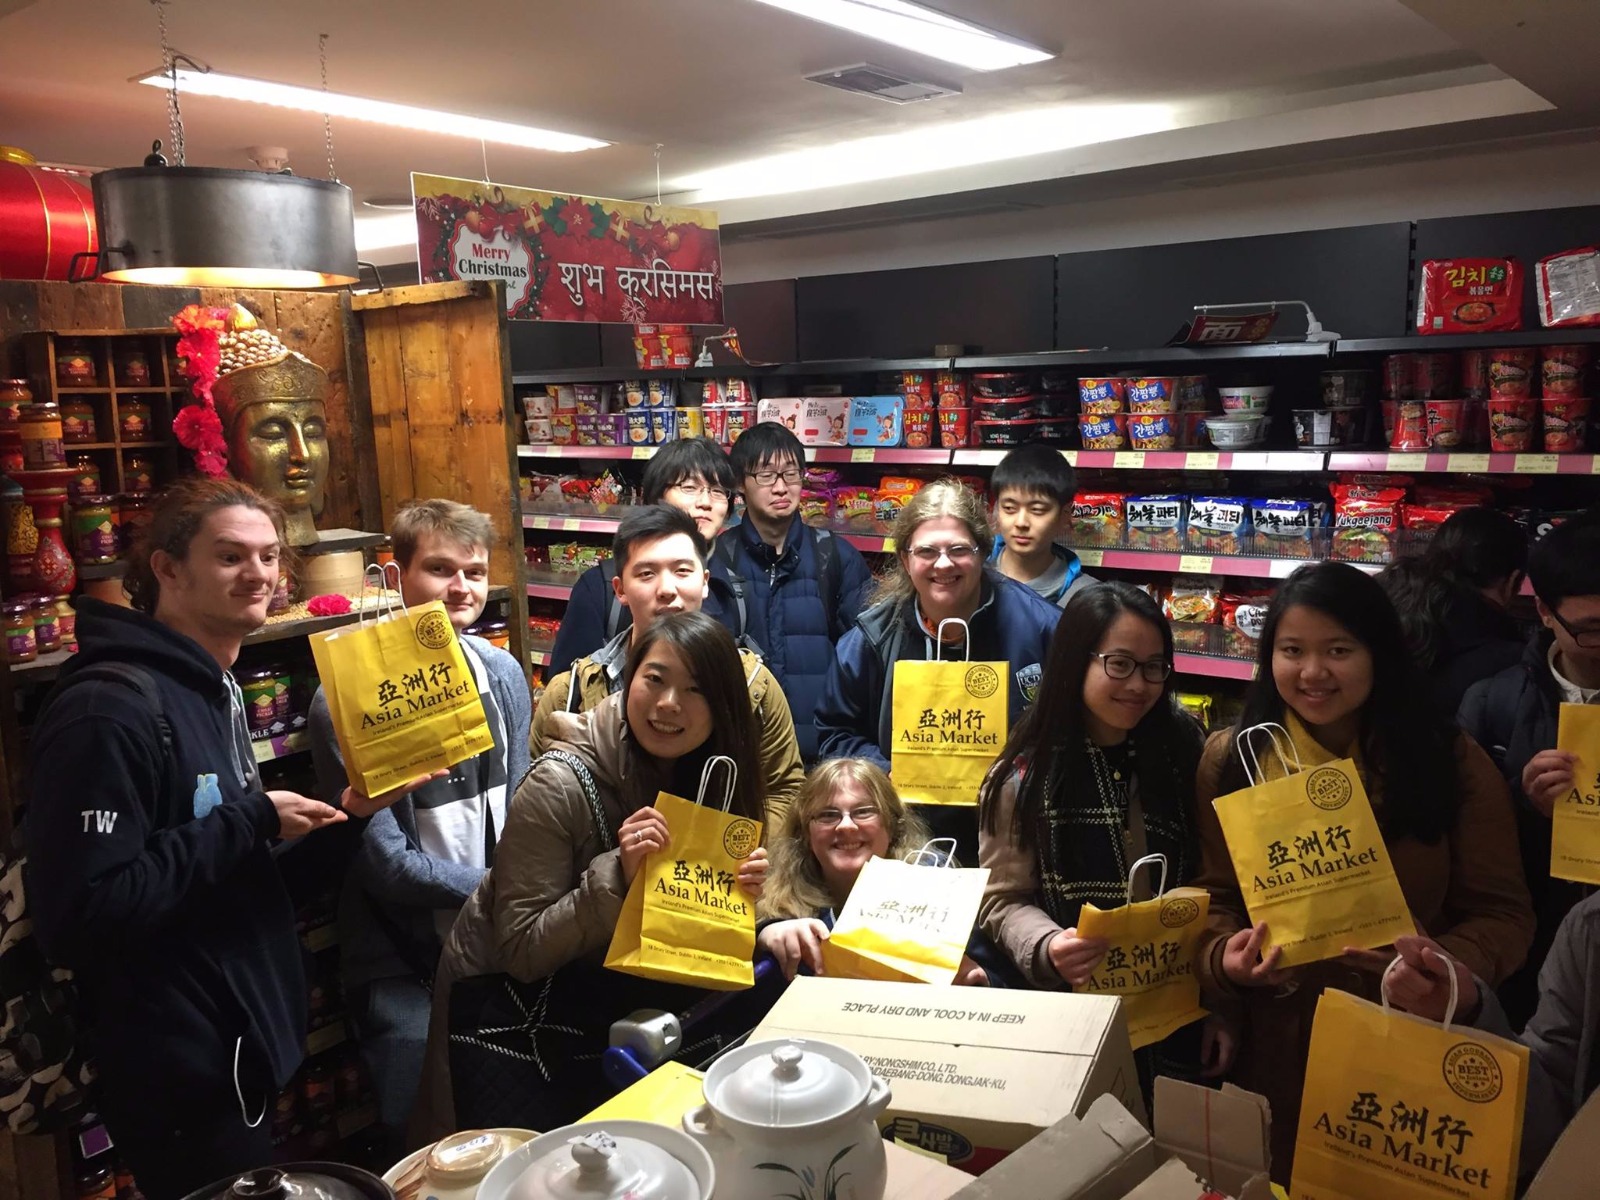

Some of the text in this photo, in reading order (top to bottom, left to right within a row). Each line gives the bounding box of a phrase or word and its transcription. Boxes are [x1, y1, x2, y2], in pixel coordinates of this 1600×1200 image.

[472, 243, 510, 262] Merry
[458, 258, 527, 279] Christmas
[1444, 265, 1487, 287] 김치
[558, 262, 604, 306] शुभ
[1335, 512, 1392, 528] Yukgaejang
[378, 661, 452, 708] 亞洲行
[1021, 674, 1041, 685] UCD
[361, 680, 470, 730] Asia Market
[917, 708, 986, 731] 亞洲行
[254, 729, 269, 740] KLE
[900, 729, 998, 745] Asia Market
[1317, 780, 1340, 795] BEST
[81, 810, 118, 834] TW
[732, 834, 751, 842] BEST
[1268, 825, 1352, 871] 亞洲行
[673, 860, 736, 897] 亞洲行
[1252, 847, 1378, 893] Asia Market
[654, 877, 748, 916] Asia Market
[1105, 942, 1182, 973] 亞洲行
[1087, 961, 1193, 991] Asia Market
[841, 1002, 1026, 1025] KEEP IN A COOL AND DRY PLACE
[1458, 1064, 1489, 1076] BEST
[1345, 1092, 1474, 1156] 亞洲行
[1313, 1111, 1492, 1189] Asia Market
